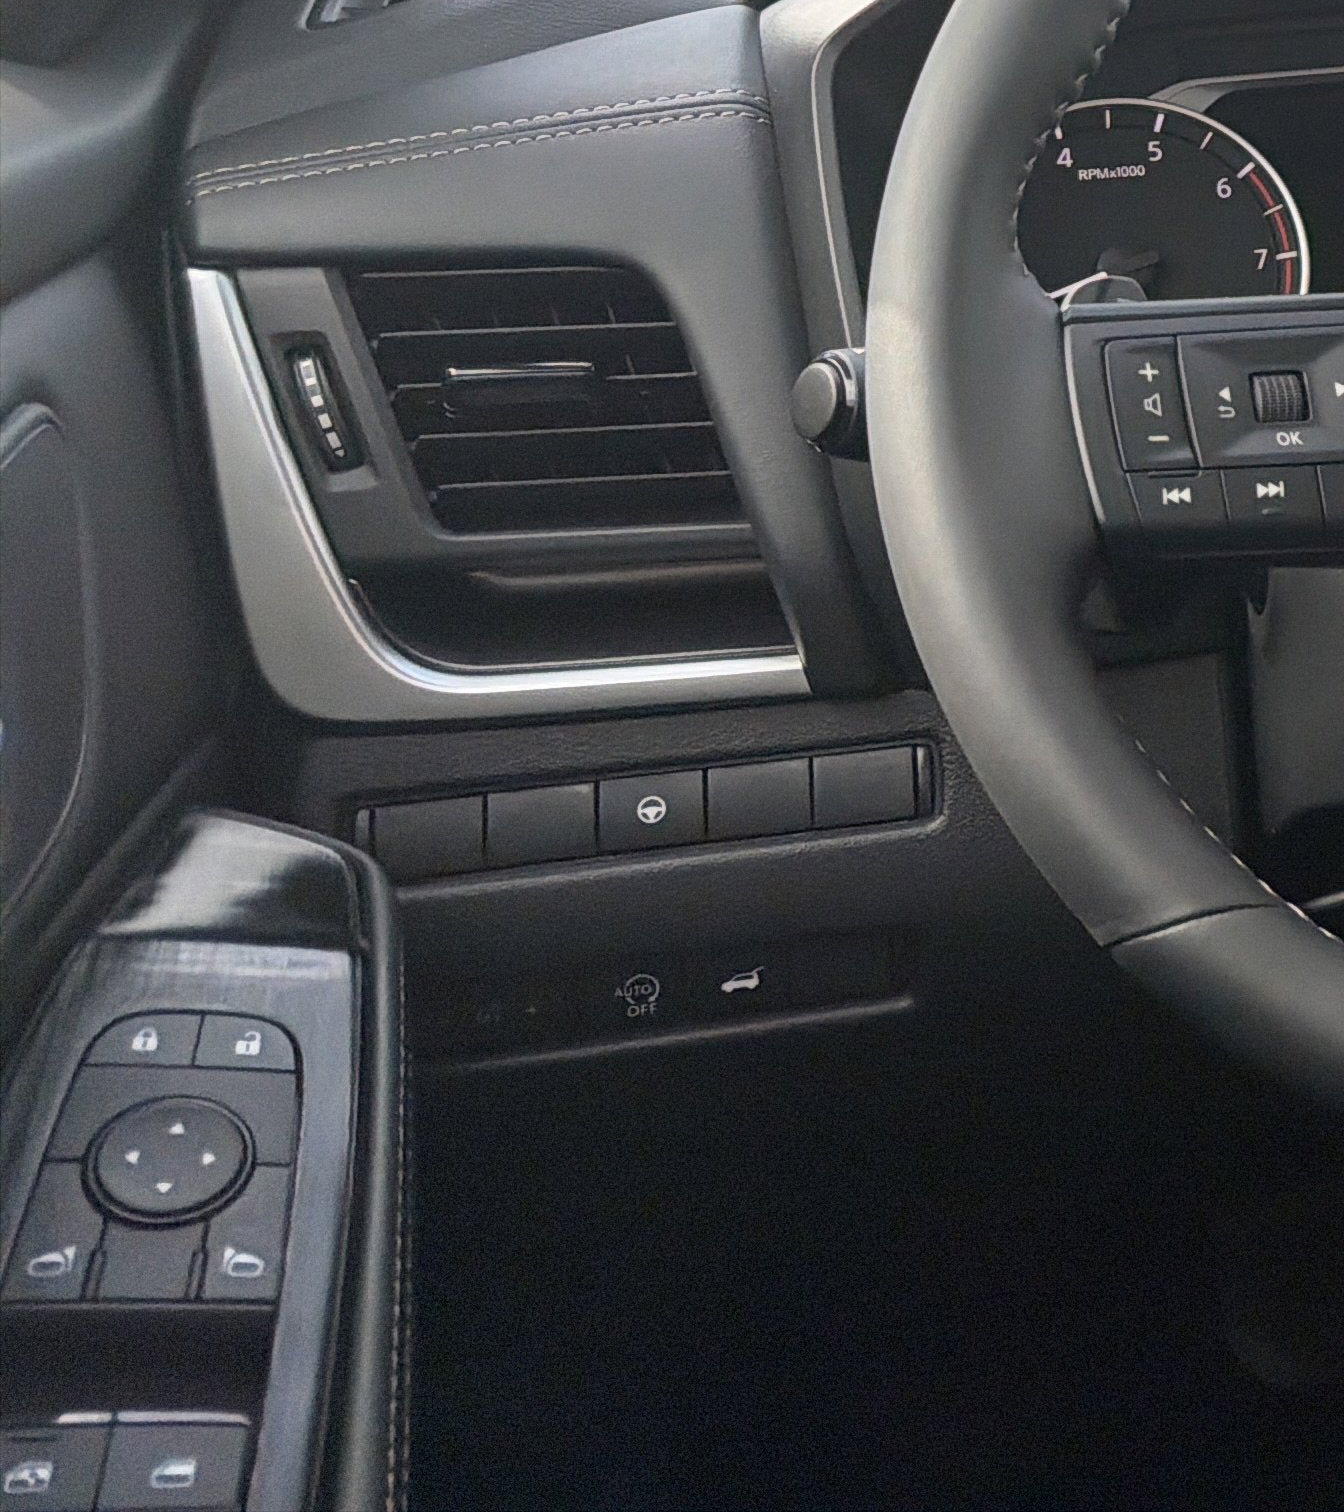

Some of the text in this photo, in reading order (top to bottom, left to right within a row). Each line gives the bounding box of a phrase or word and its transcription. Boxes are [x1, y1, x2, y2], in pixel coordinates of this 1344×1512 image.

[1056, 146, 1074, 169] 4
[1147, 140, 1164, 162] 5
[1077, 164, 1146, 181] RPMx1000
[1216, 176, 1233, 199] 6
[1252, 247, 1269, 271] 7
[1276, 431, 1305, 447] OK
[614, 983, 653, 998] AUTO
[627, 1002, 658, 1017] OFF
